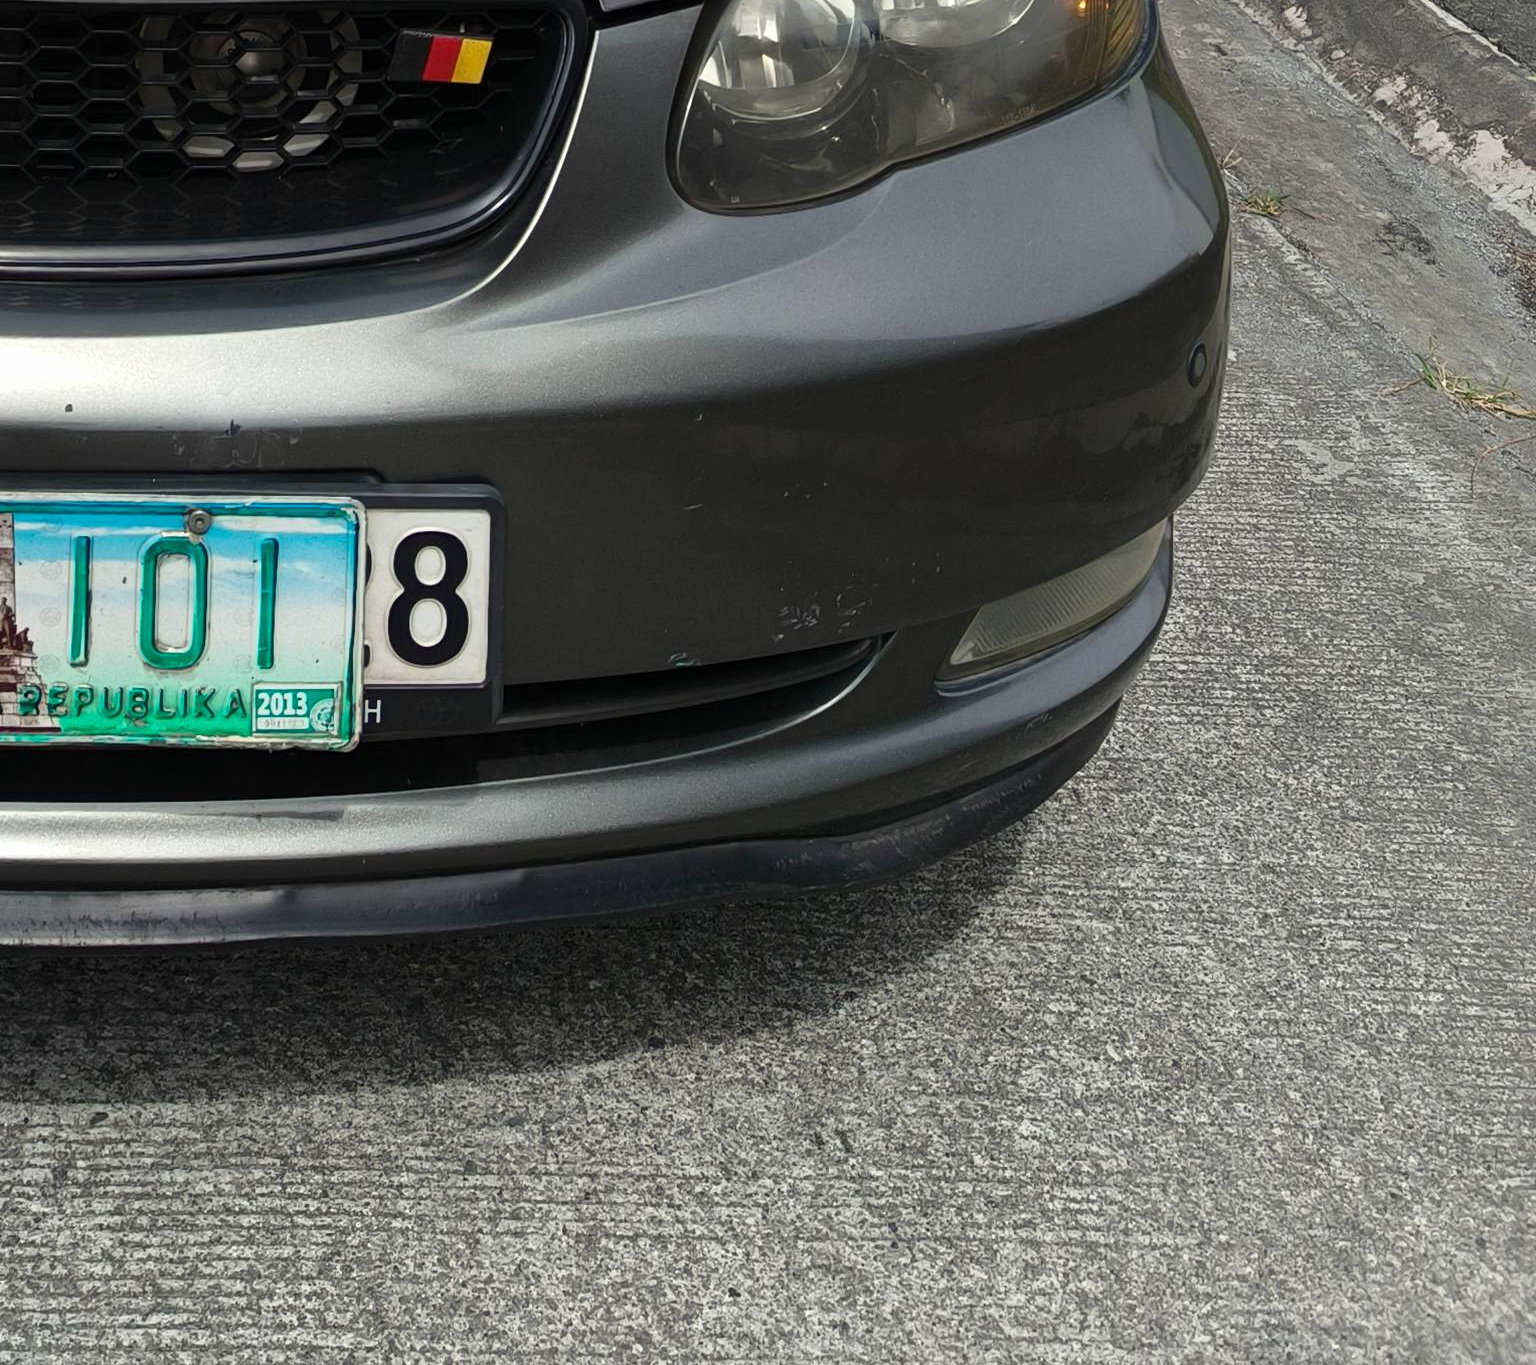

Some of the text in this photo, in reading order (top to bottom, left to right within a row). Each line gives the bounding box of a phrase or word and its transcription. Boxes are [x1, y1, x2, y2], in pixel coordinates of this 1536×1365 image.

[68, 533, 279, 670] 101
[364, 530, 470, 667] 8
[18, 682, 249, 719] REPUBLIKA
[257, 692, 308, 716] 2013
